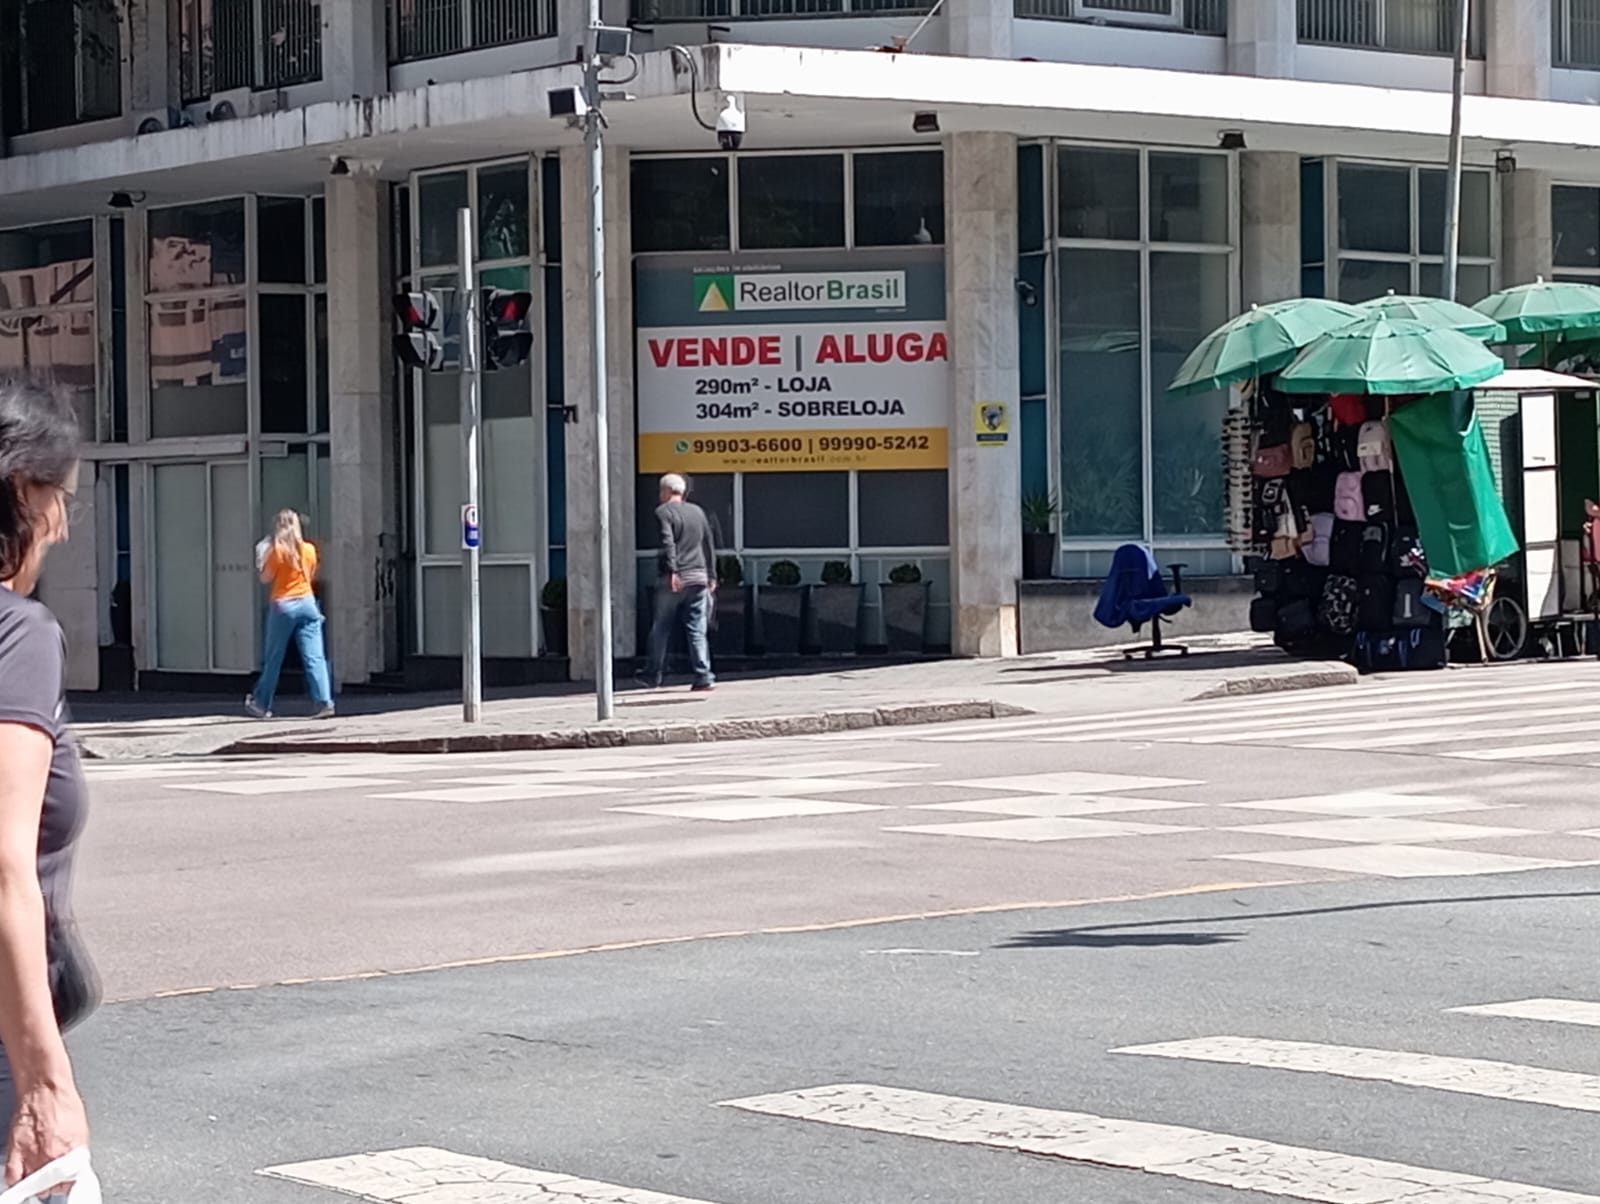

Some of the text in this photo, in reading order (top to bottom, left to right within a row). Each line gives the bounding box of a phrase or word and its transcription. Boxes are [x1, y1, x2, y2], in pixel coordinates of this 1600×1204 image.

[740, 278, 899, 303] RealtorBrasil
[648, 336, 782, 368] VENDE
[816, 332, 948, 363] ALUGA
[695, 378, 759, 395] 290m²
[778, 376, 832, 393] LOJA
[696, 402, 759, 419] 304m²
[778, 400, 905, 417] SOBRELOJA
[693, 438, 802, 453] 99903-6600
[819, 436, 929, 451] 99990-5242
